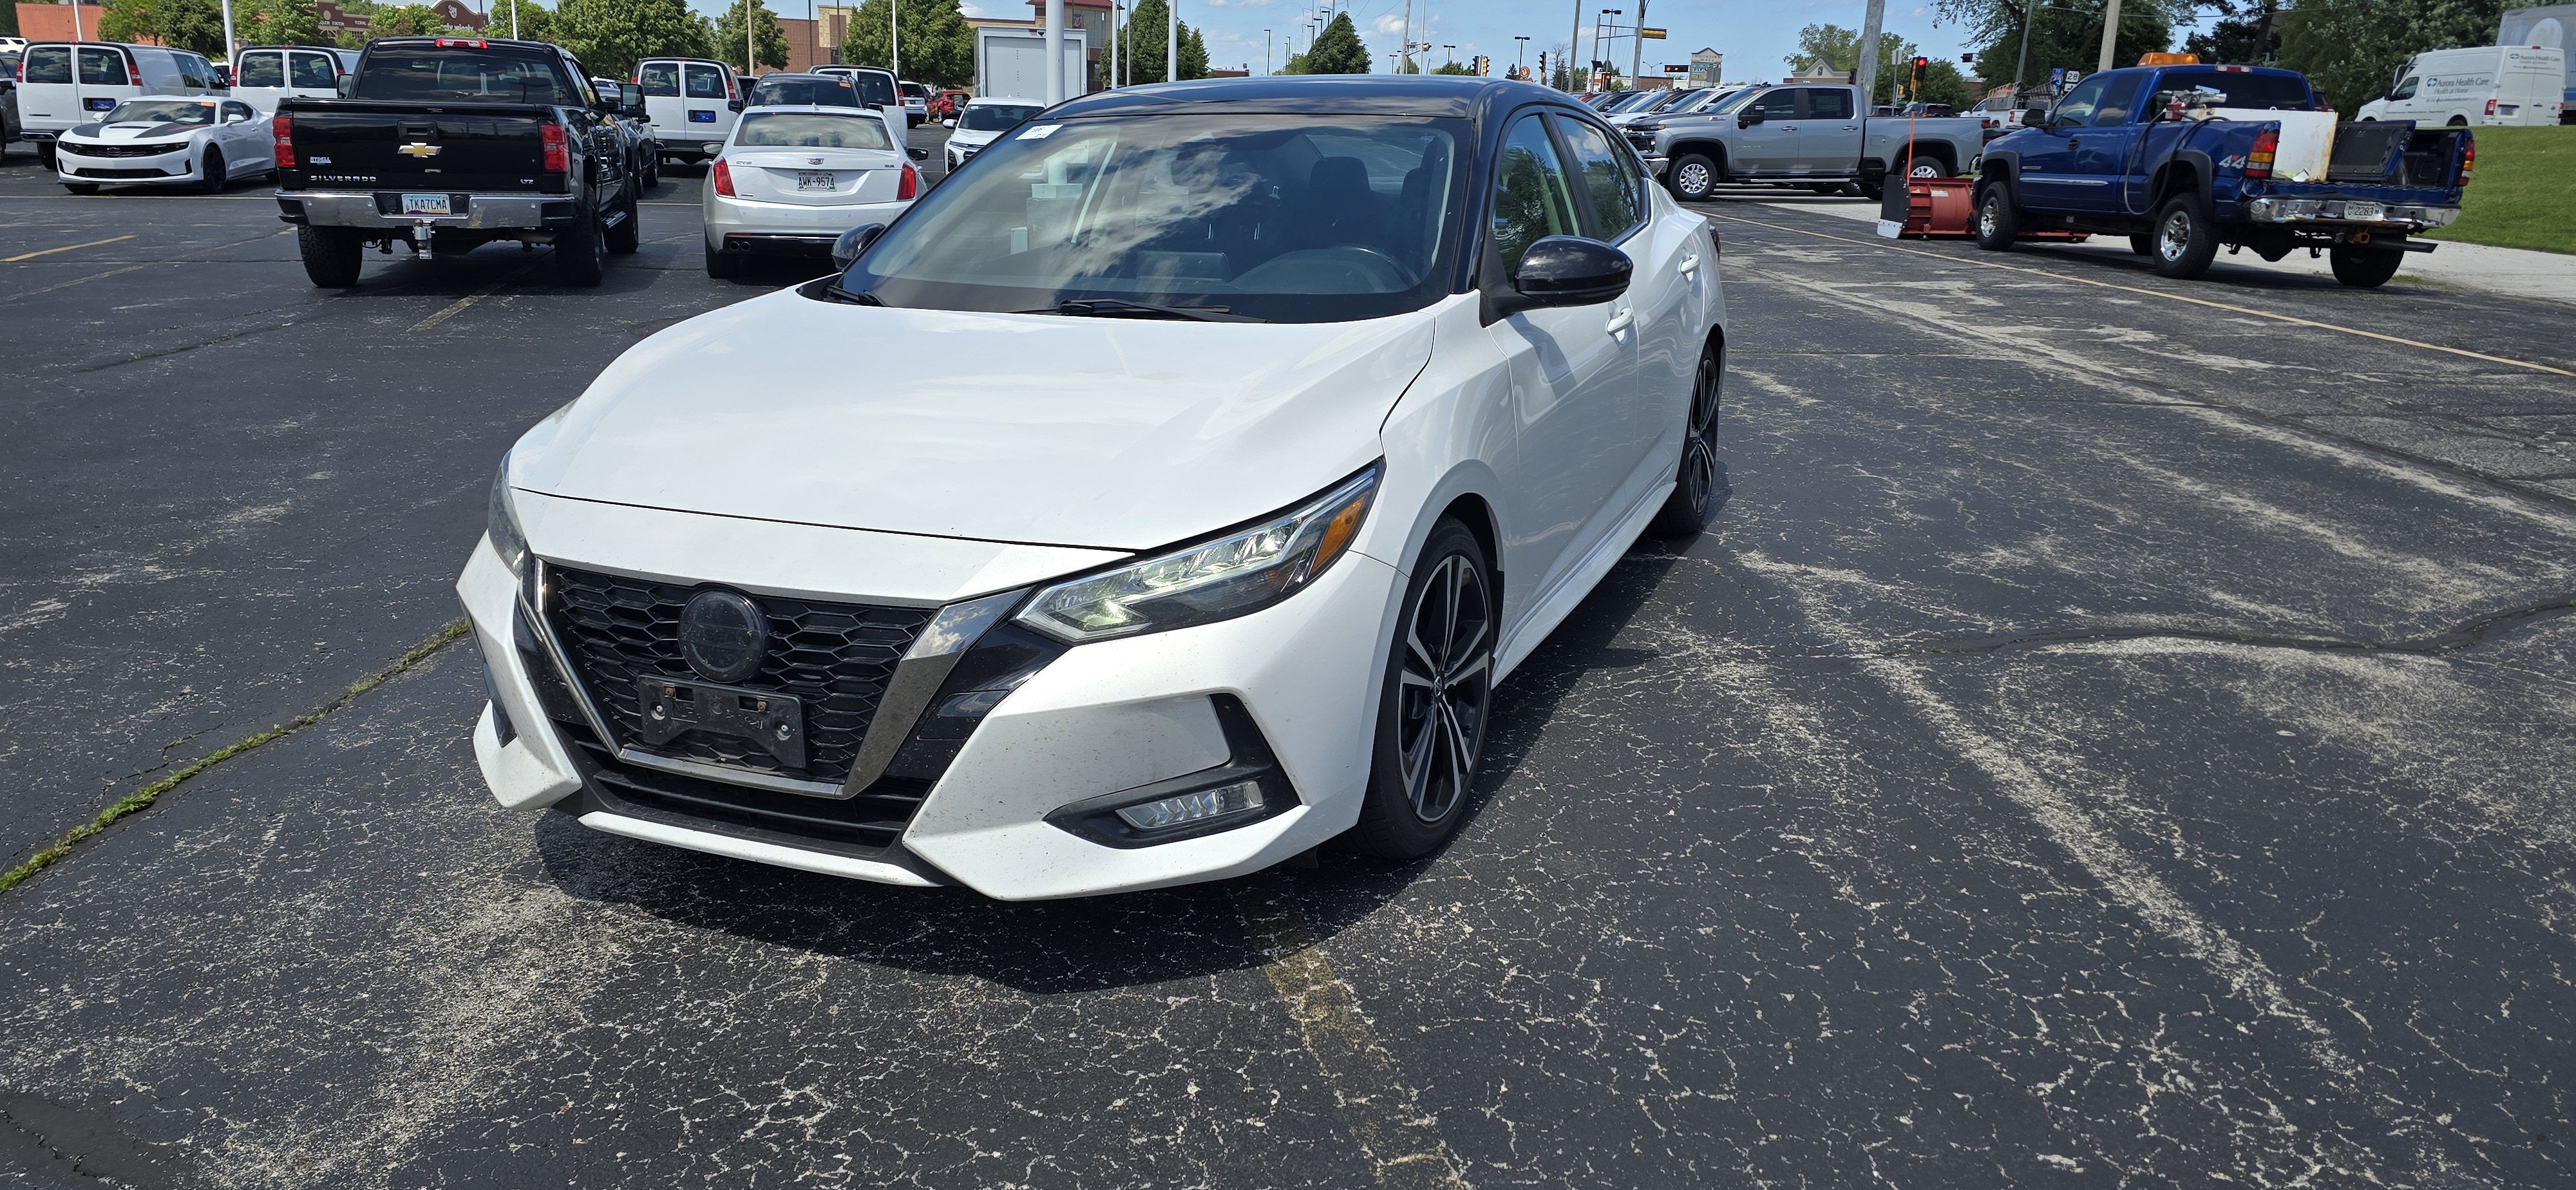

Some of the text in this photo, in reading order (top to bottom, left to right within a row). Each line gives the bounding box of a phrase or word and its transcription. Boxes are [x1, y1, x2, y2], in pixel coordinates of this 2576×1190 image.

[2456, 77, 2474, 86] Health
[799, 176, 835, 187] AWK-9574
[409, 199, 447, 210] TKA7CMA
